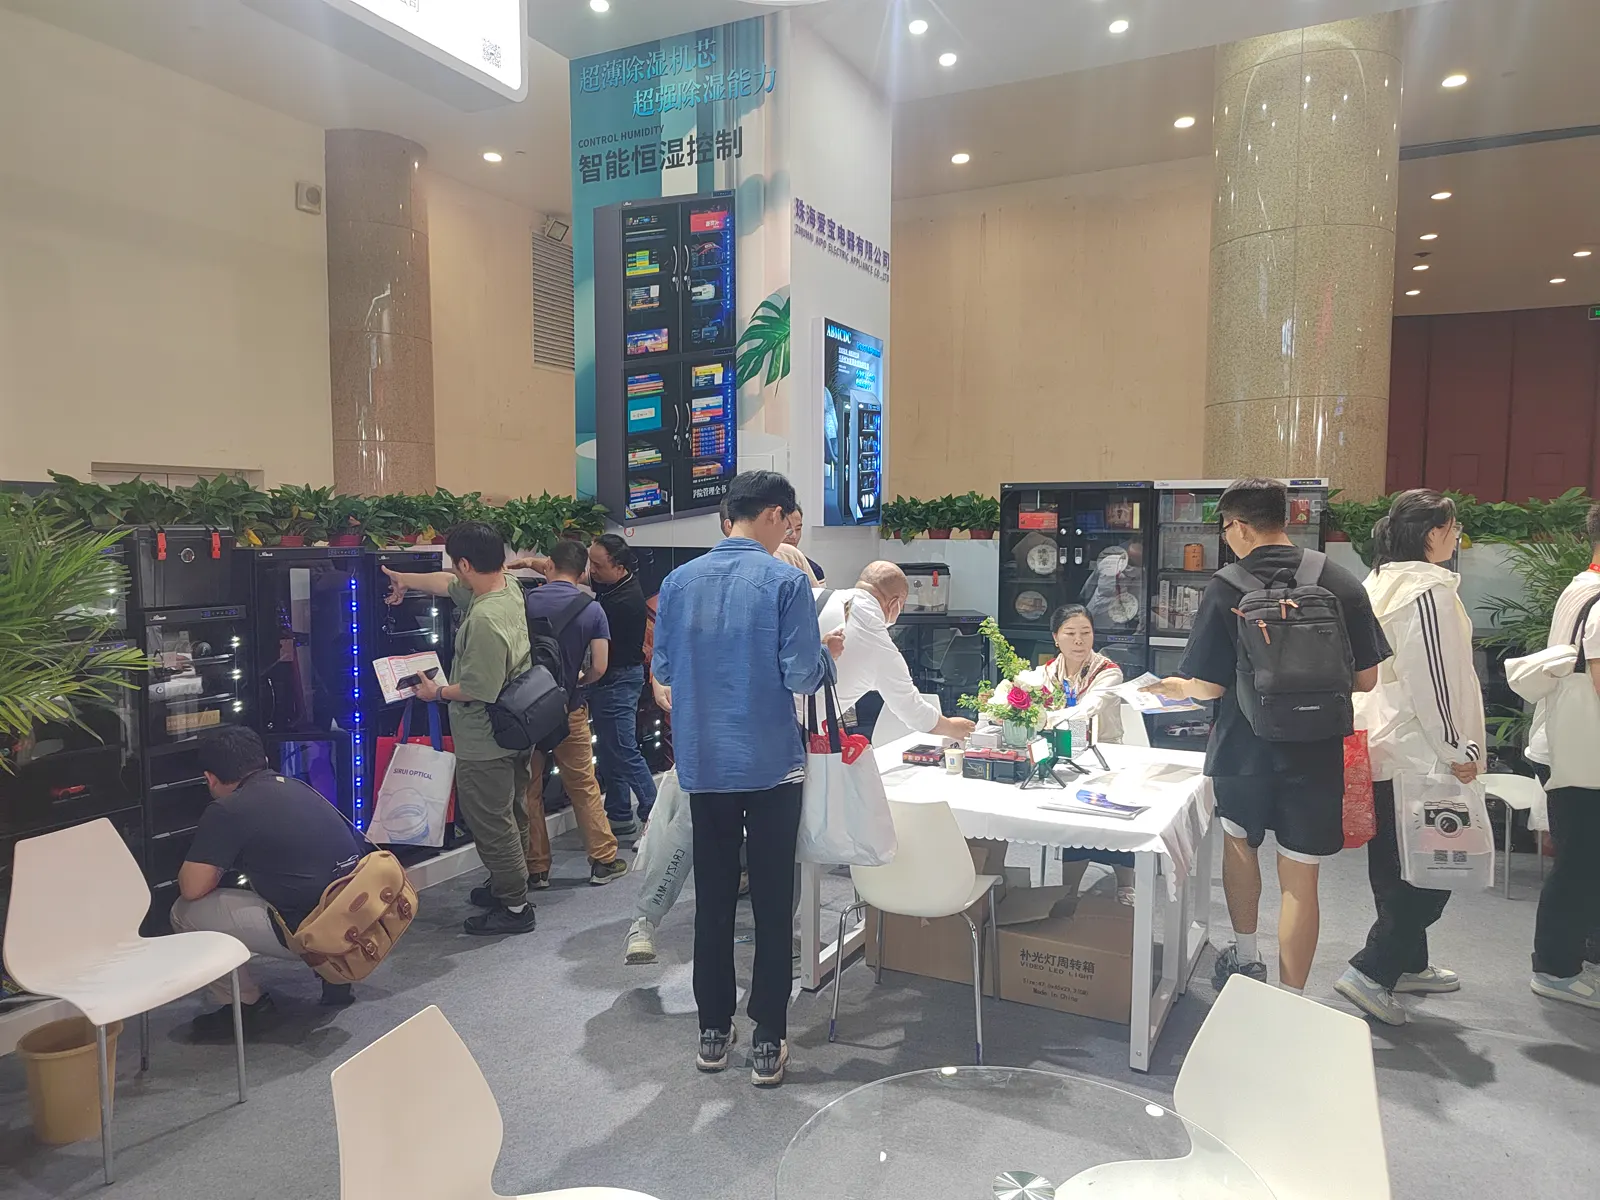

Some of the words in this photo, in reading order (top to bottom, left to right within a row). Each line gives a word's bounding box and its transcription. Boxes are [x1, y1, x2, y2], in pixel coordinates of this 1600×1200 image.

[580, 39, 717, 93] 超薄除湿机芯
[632, 63, 777, 118] 超强除湿能力
[578, 133, 619, 149] CONTROL
[621, 125, 665, 140] HUMIDITY
[578, 127, 743, 184] 智能恒湿控制
[795, 197, 890, 271] 珠海爱宝电器有限公司
[828, 243, 849, 261] ELECTRIC
[409, 770, 432, 780] OPTICAL
[1020, 948, 1095, 974] 补光灯周转箱
